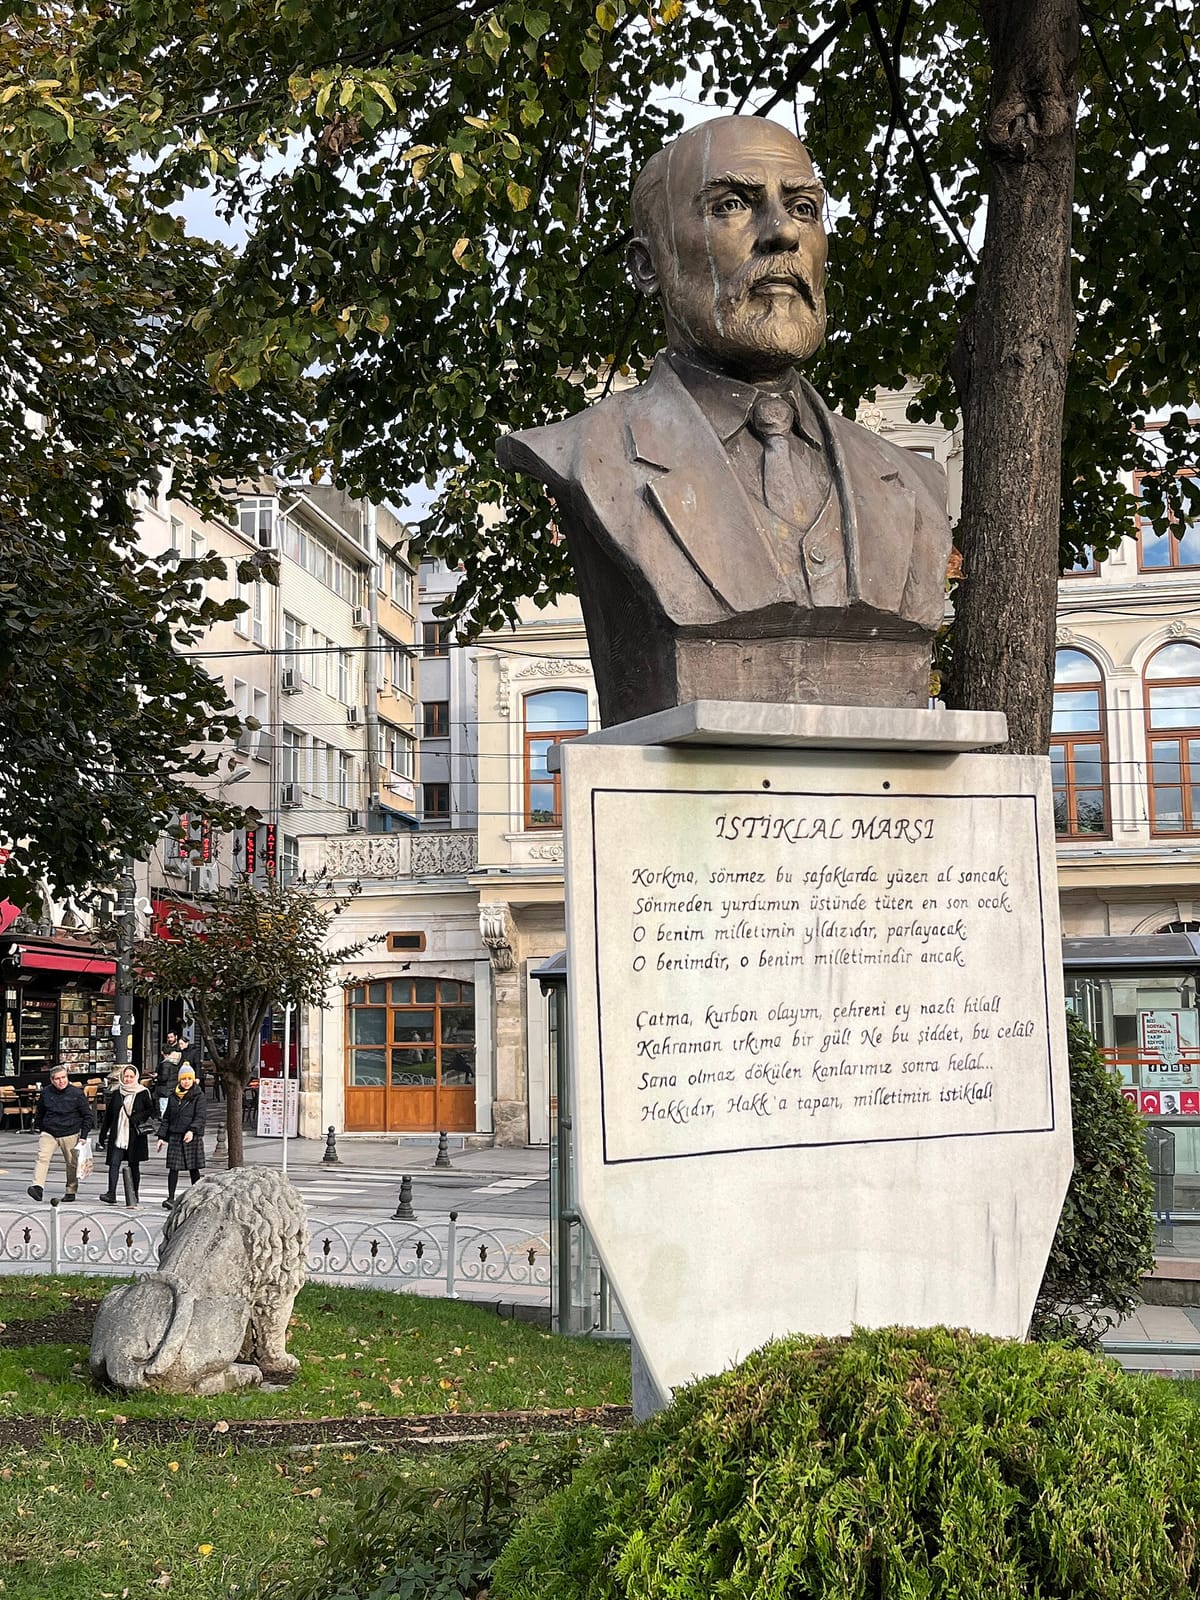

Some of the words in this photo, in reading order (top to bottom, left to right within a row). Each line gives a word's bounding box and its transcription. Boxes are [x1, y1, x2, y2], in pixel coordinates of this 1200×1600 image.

[715, 813, 842, 843] İSTİKLAL
[632, 866, 697, 889] Korkma,
[709, 868, 765, 883] sönmez
[776, 866, 792, 883] bu
[803, 865, 878, 889] şafaklarda
[885, 869, 928, 890] yüzen
[937, 865, 953, 882] al
[633, 894, 712, 915] Sönmeden
[721, 893, 799, 918] yurdumun
[810, 893, 866, 910] üstünde
[875, 895, 913, 910] tüten
[922, 899, 937, 909] en
[947, 899, 968, 909] son
[978, 892, 1012, 913] ocak.
[633, 926, 645, 944] O
[657, 923, 704, 941] benim
[715, 919, 794, 940] milletimin
[633, 956, 646, 972] O
[657, 951, 729, 971] benimdir,
[741, 956, 749, 967] o
[759, 949, 804, 967] benim
[815, 945, 912, 967] milletimindir
[921, 946, 965, 967] ancak.
[636, 1011, 692, 1031] Çatma,
[705, 1004, 757, 1029] kurban
[768, 1002, 822, 1027] olayım,
[833, 1000, 886, 1023] çehreni
[895, 1005, 910, 1022] ey
[964, 995, 1001, 1013] hilal!
[637, 1036, 722, 1060] Kahraman
[792, 1029, 813, 1046] bir
[820, 1028, 851, 1053] gül!
[861, 1027, 882, 1047] Ne
[892, 1025, 909, 1043] bu
[918, 1024, 963, 1045] şiddet,
[972, 1023, 989, 1040] bu
[637, 1072, 676, 1090] Sana
[688, 1069, 735, 1085] olmaz
[745, 1061, 802, 1085] dökülen
[812, 1059, 892, 1082] kanlarımız
[901, 1061, 938, 1074] sonra
[641, 1098, 714, 1124] Hakkıdır,
[798, 1097, 842, 1116] tapan,
[854, 1087, 931, 1106] milletimin
[940, 1082, 992, 1104] istiklal!
